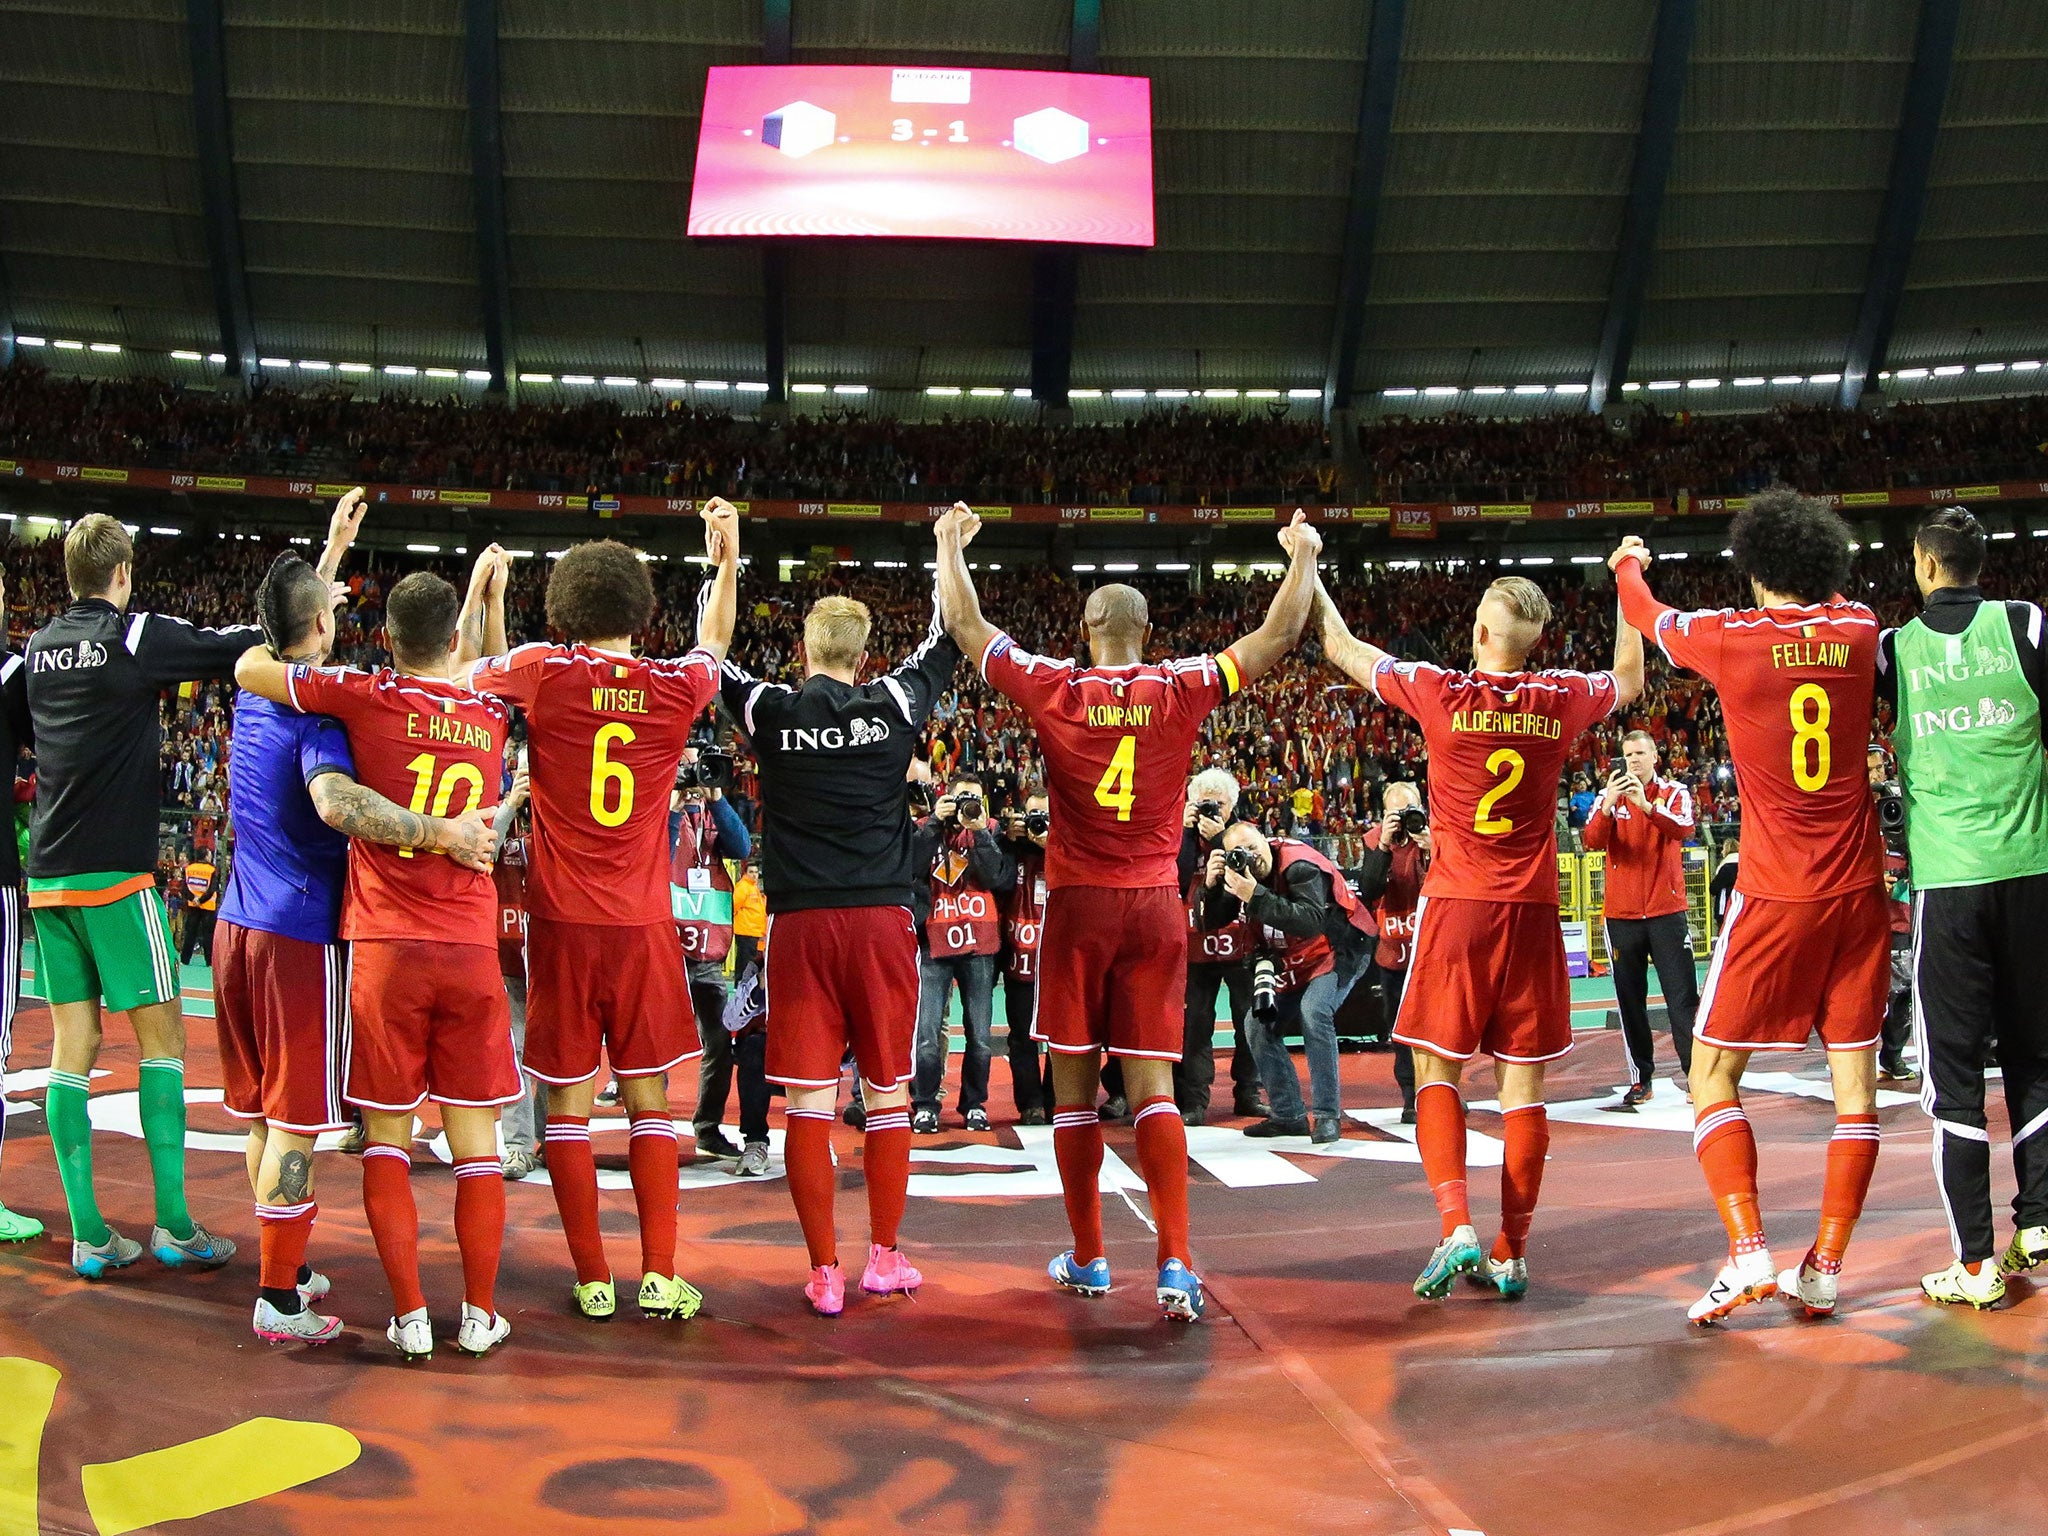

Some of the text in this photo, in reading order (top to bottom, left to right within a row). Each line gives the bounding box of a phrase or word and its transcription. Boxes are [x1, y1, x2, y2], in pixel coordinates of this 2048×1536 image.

[891, 119, 913, 141] 3
[948, 120, 969, 142] 1
[57, 466, 78, 477] 1895
[171, 475, 194, 487] 1895
[289, 482, 312, 493] 1895
[412, 490, 436, 501] 1895
[538, 495, 563, 506] 1895
[1930, 489, 1952, 500] 1895
[667, 500, 692, 512] 1895
[799, 504, 824, 515] 1895
[1576, 503, 1600, 514] 1895
[1698, 499, 1722, 510] 1895
[1061, 508, 1086, 519] 1895
[1150, 513, 1156, 522] E
[1193, 509, 1218, 519] 1895
[1324, 508, 1349, 519] 1895
[1397, 511, 1430, 524] 1895
[1452, 506, 1477, 517] 1895
[1568, 509, 1575, 518] D
[34, 650, 73, 673] ING
[1772, 642, 1850, 668] FELLAINI
[1909, 660, 1970, 693] ING
[592, 687, 648, 714] WITSEL
[1088, 705, 1152, 727] KOMPANY
[1912, 705, 1972, 738] ING
[1452, 710, 1561, 740] ALDERWEIRELD
[407, 713, 492, 752] E. HAZARD
[780, 727, 844, 751] ING
[1789, 682, 1831, 792] 8
[590, 722, 637, 828] 6
[1093, 735, 1136, 821] 4
[1474, 748, 1525, 834] 2
[406, 753, 485, 858] 10
[1588, 856, 1601, 868] 30
[673, 892, 705, 915] TV
[947, 922, 976, 948] 01
[1203, 934, 1234, 955] 03
[586, 1301, 612, 1310] adidas
